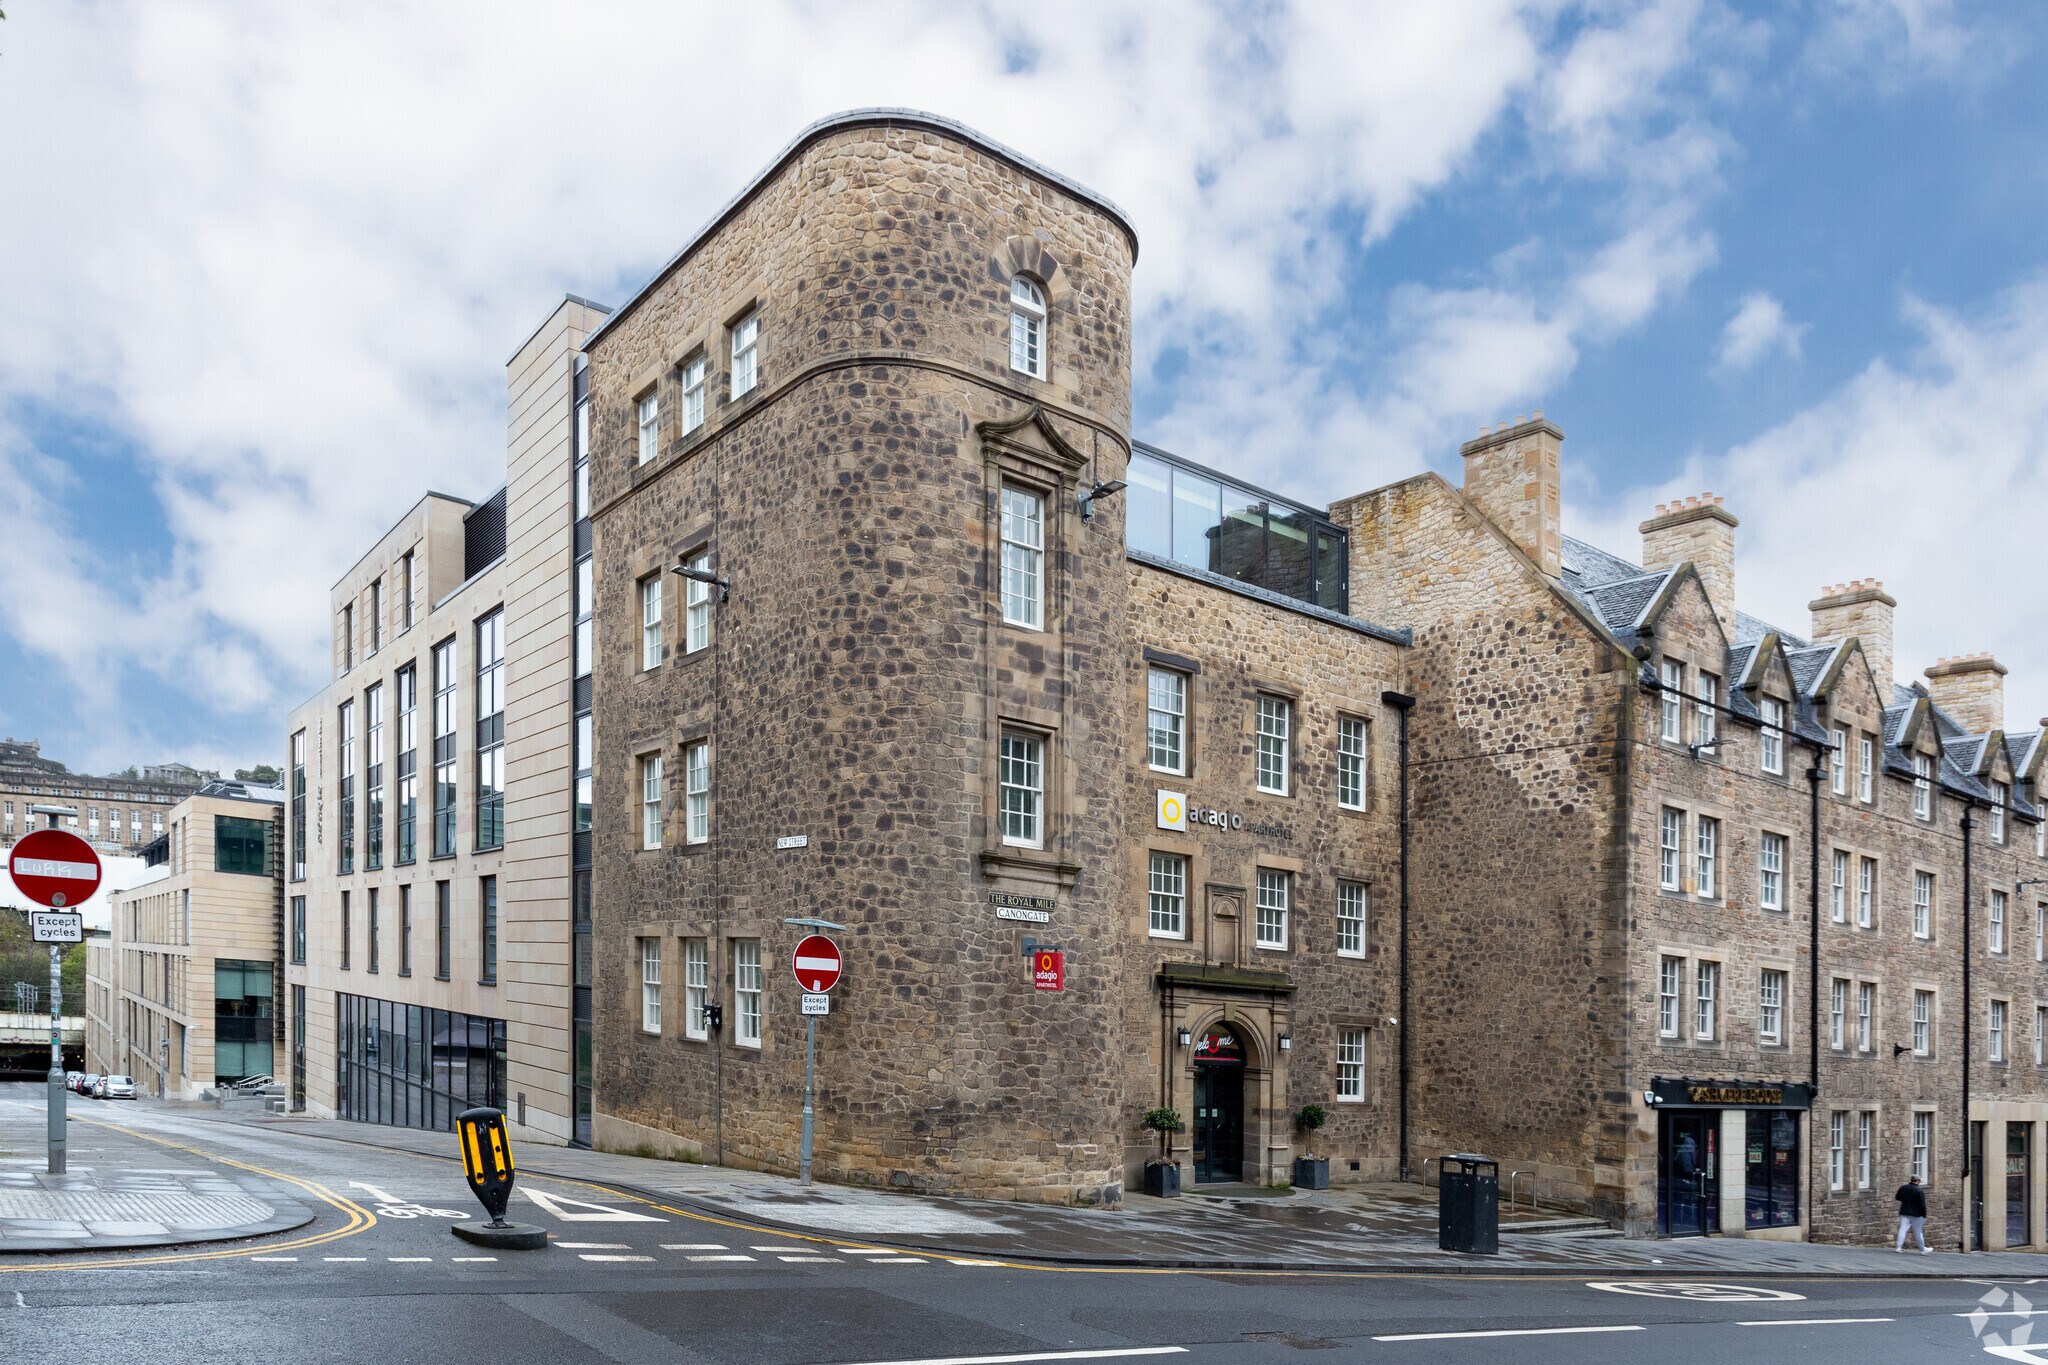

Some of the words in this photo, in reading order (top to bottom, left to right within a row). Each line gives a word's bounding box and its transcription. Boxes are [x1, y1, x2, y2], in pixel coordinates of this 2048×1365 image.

[1189, 805, 1242, 832] adagio
[788, 836, 806, 846] STREET
[990, 893, 1006, 904] THE
[1007, 896, 1033, 907] ROYAL
[1036, 899, 1054, 910] MILE
[998, 908, 1048, 922] CANONGATE
[38, 916, 77, 927] Except
[40, 928, 76, 938] cycles
[1036, 970, 1058, 982] adagio
[804, 996, 827, 1004] Except
[804, 1004, 826, 1012] cycles
[1750, 1087, 1782, 1104] HOUSE
